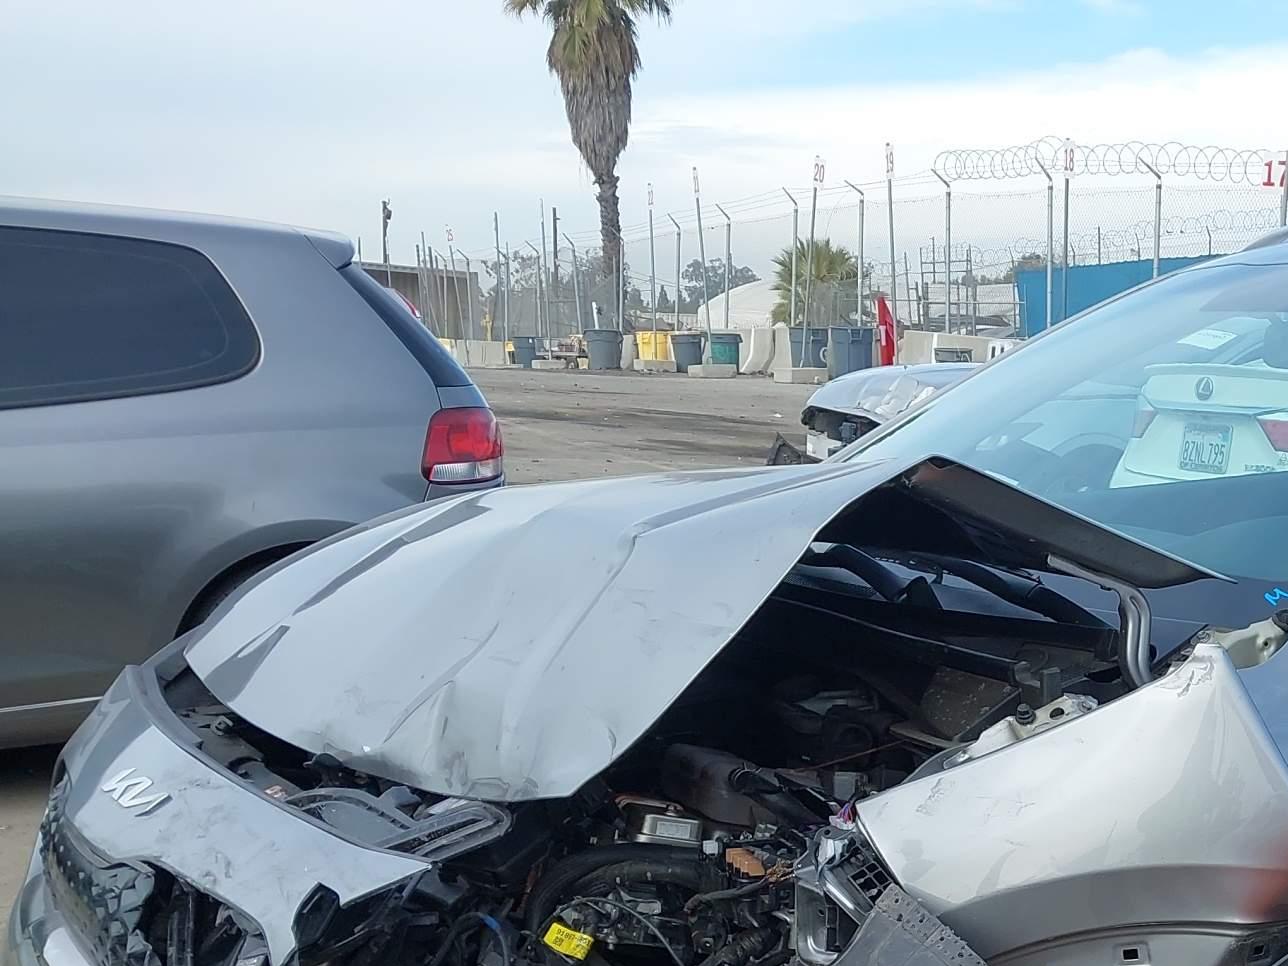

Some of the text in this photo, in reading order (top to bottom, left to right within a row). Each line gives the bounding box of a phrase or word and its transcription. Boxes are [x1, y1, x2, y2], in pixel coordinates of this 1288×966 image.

[886, 151, 894, 173] 19
[1064, 148, 1074, 171] 18
[813, 163, 824, 183] 20
[1262, 160, 1288, 187] 17
[1182, 440, 1225, 465] 8ZNL795
